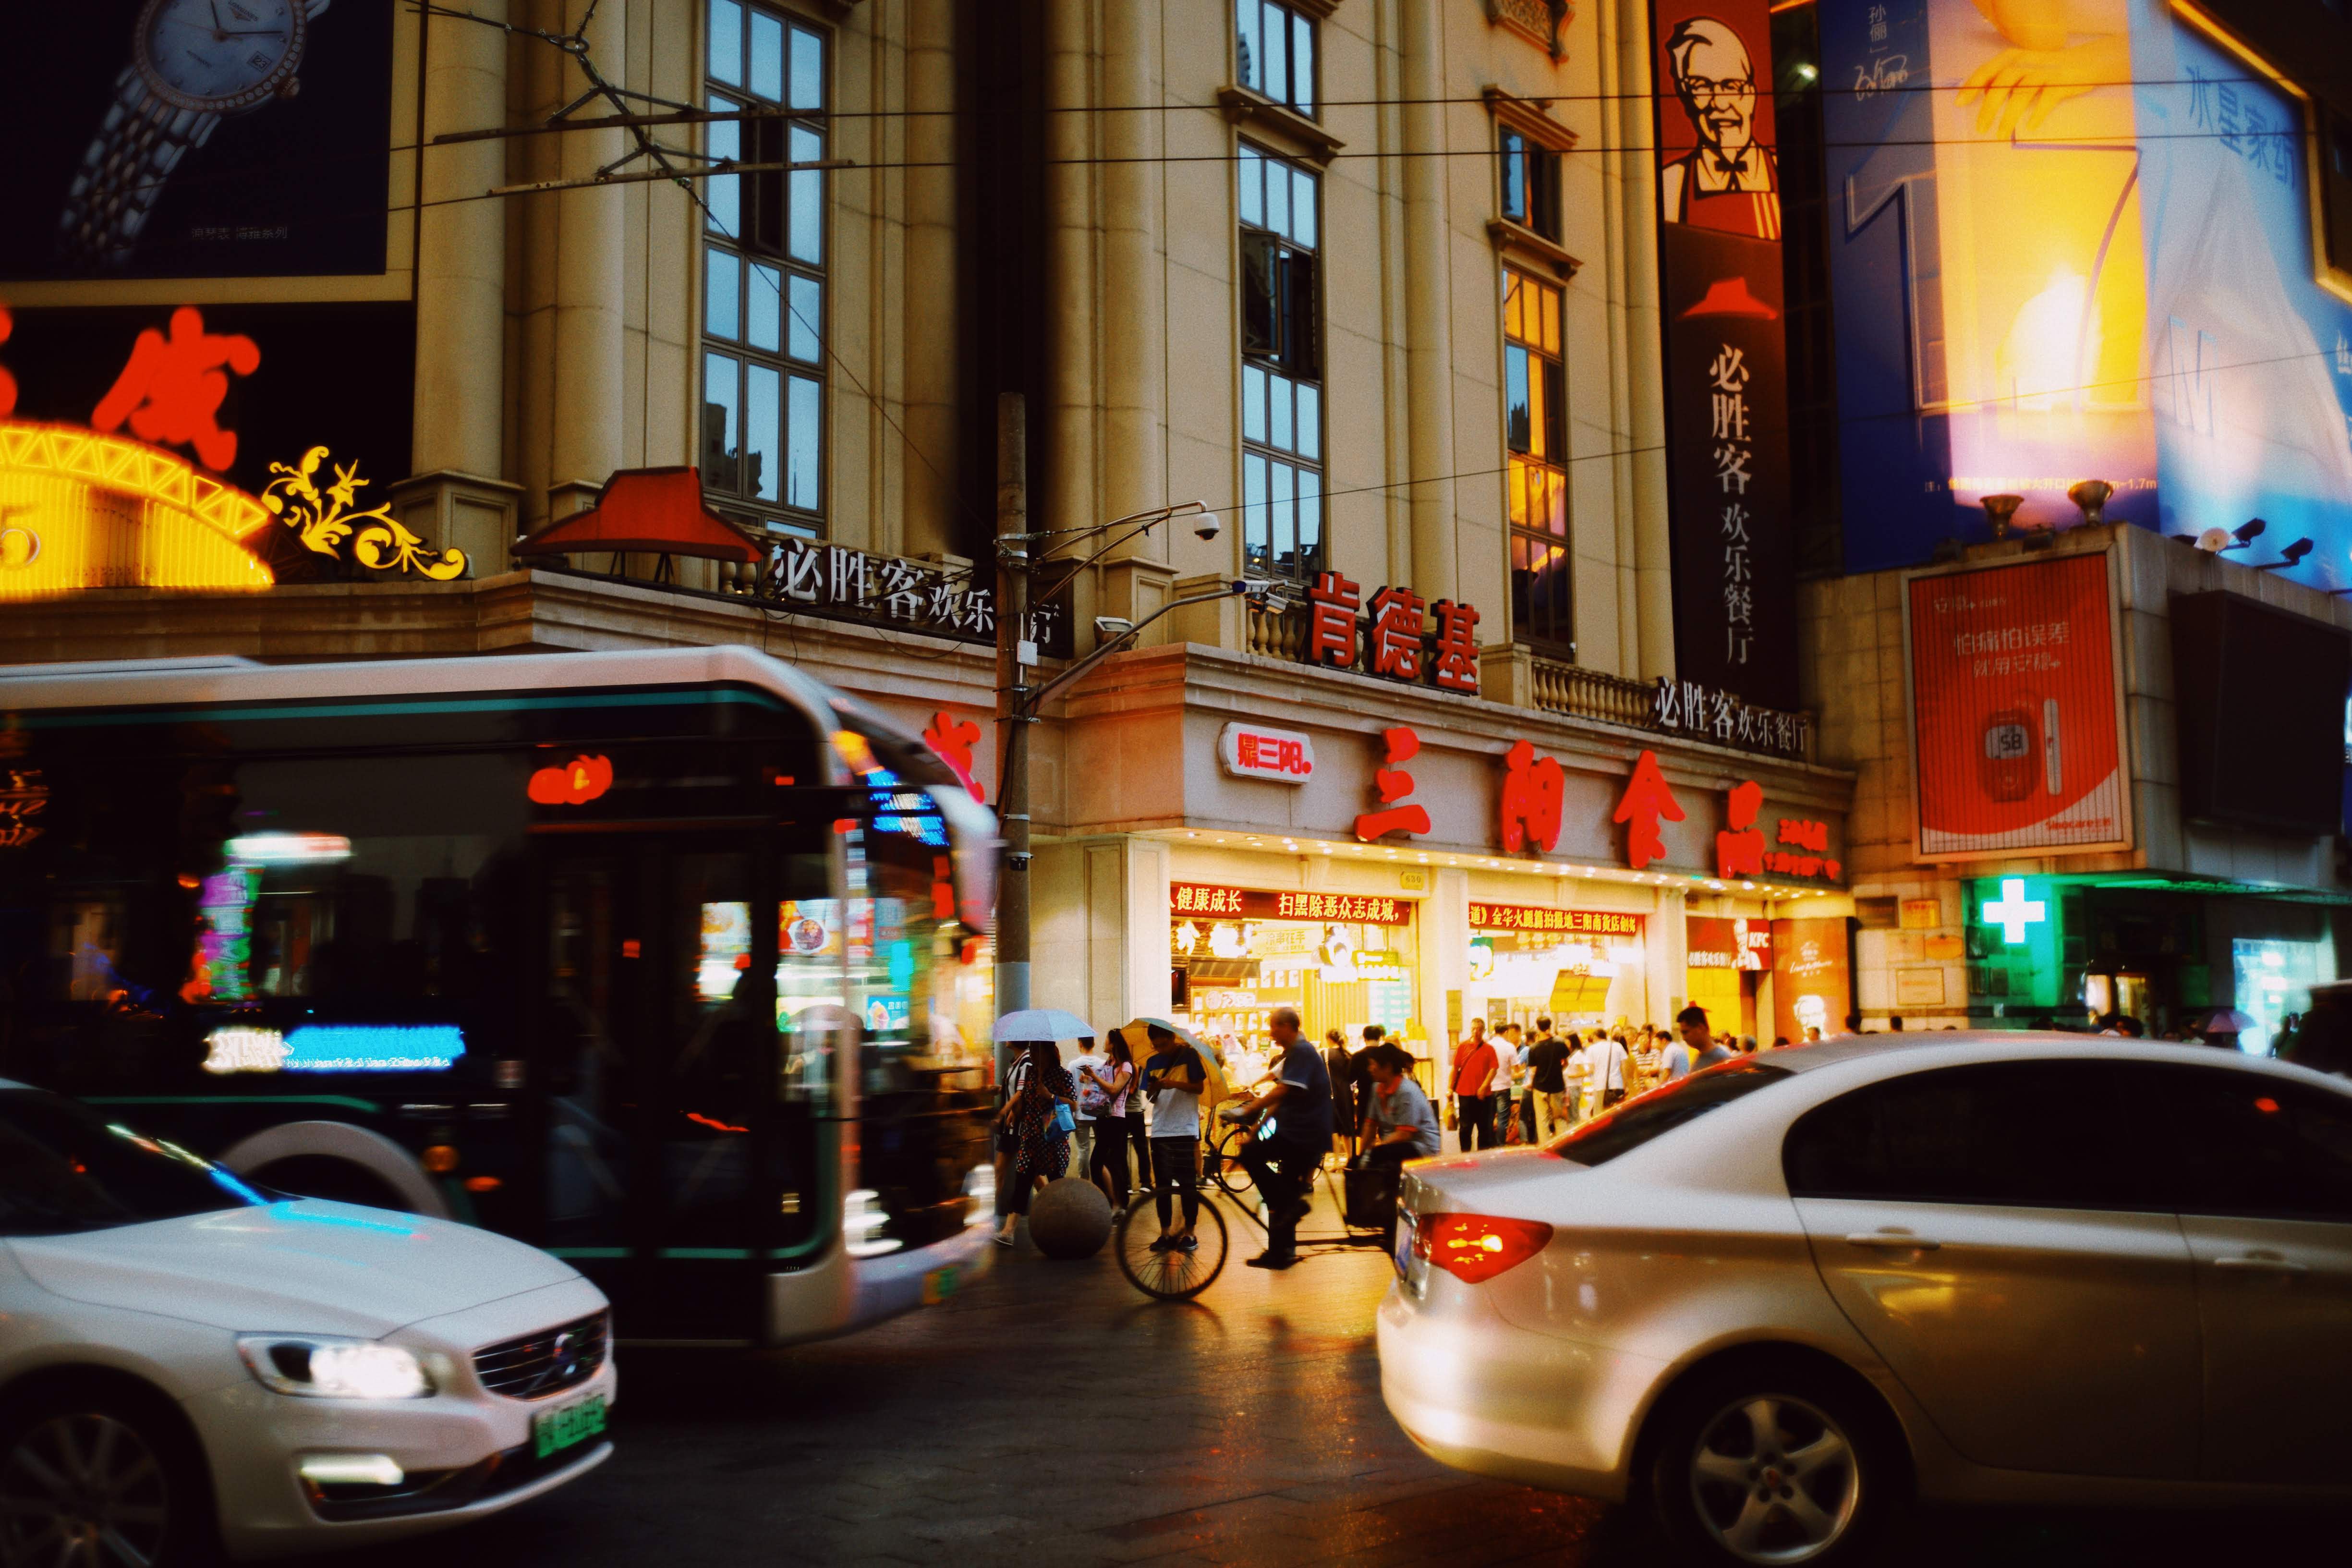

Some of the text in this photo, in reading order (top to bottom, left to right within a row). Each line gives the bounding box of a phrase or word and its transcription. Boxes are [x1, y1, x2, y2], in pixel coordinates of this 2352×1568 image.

[1709, 343, 1754, 665] 必胜客欢乐餐厅
[775, 538, 1060, 644] 必胜客欢乐厅
[1309, 571, 1480, 694] 肯德基
[1953, 621, 2070, 656] 怕痛怕误差
[1655, 677, 1807, 753] 必胜客欢乐餐厅
[1749, 932, 1770, 948] KFC
